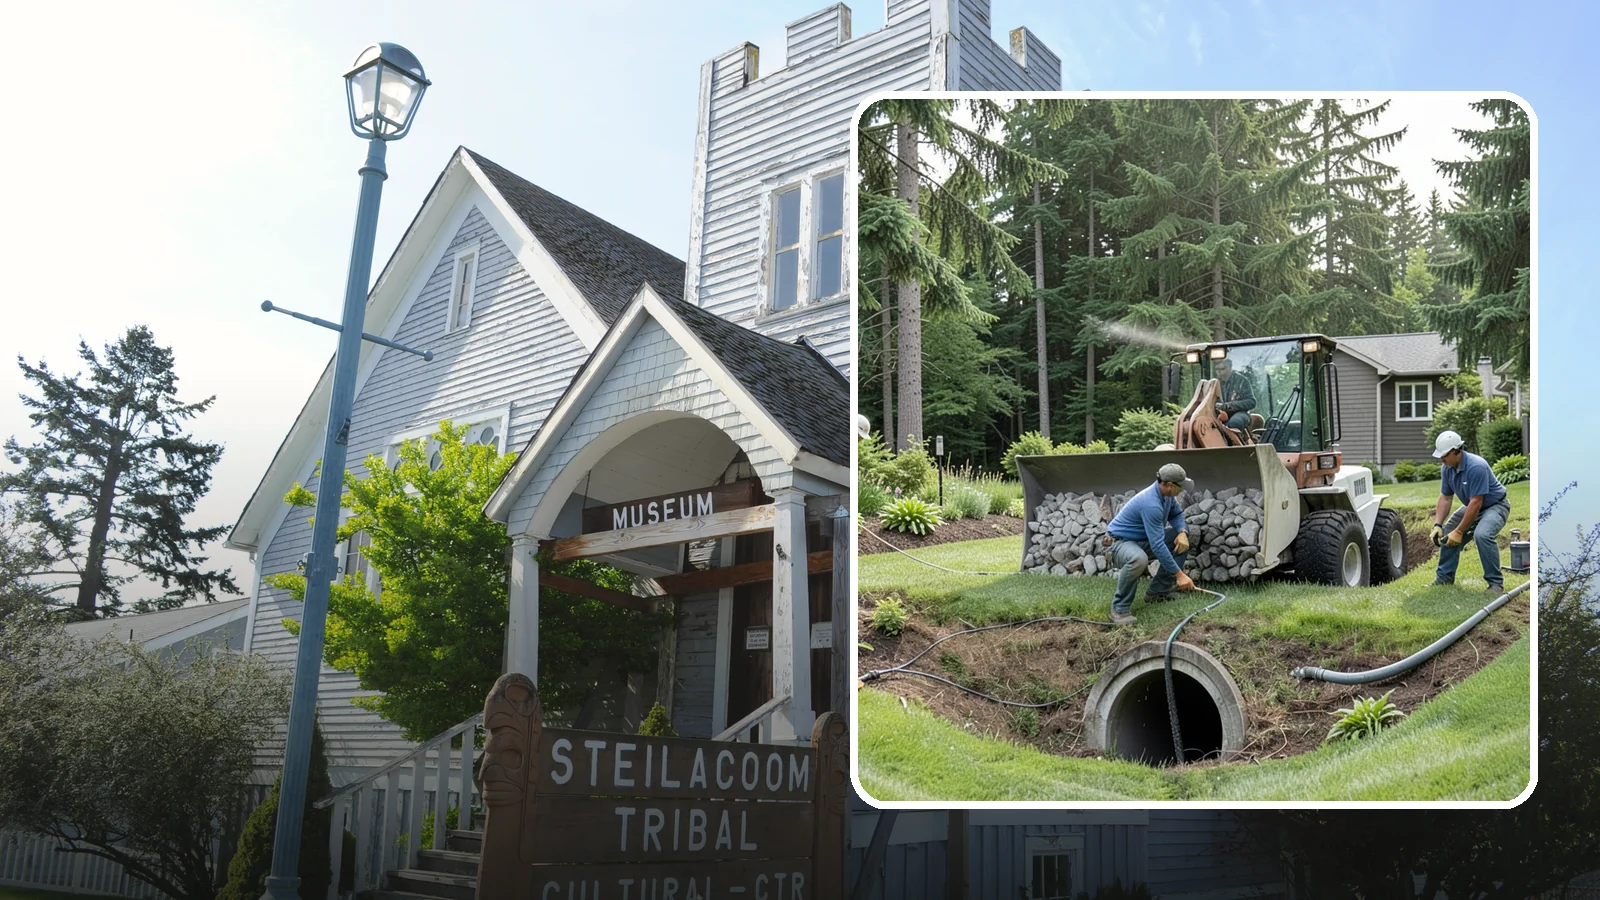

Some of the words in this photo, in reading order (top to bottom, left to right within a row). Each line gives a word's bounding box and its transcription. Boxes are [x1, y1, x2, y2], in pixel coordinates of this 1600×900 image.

[612, 491, 714, 531] MUSEUM
[550, 737, 810, 793] STEILACOOM
[615, 806, 758, 852] TRIBAL
